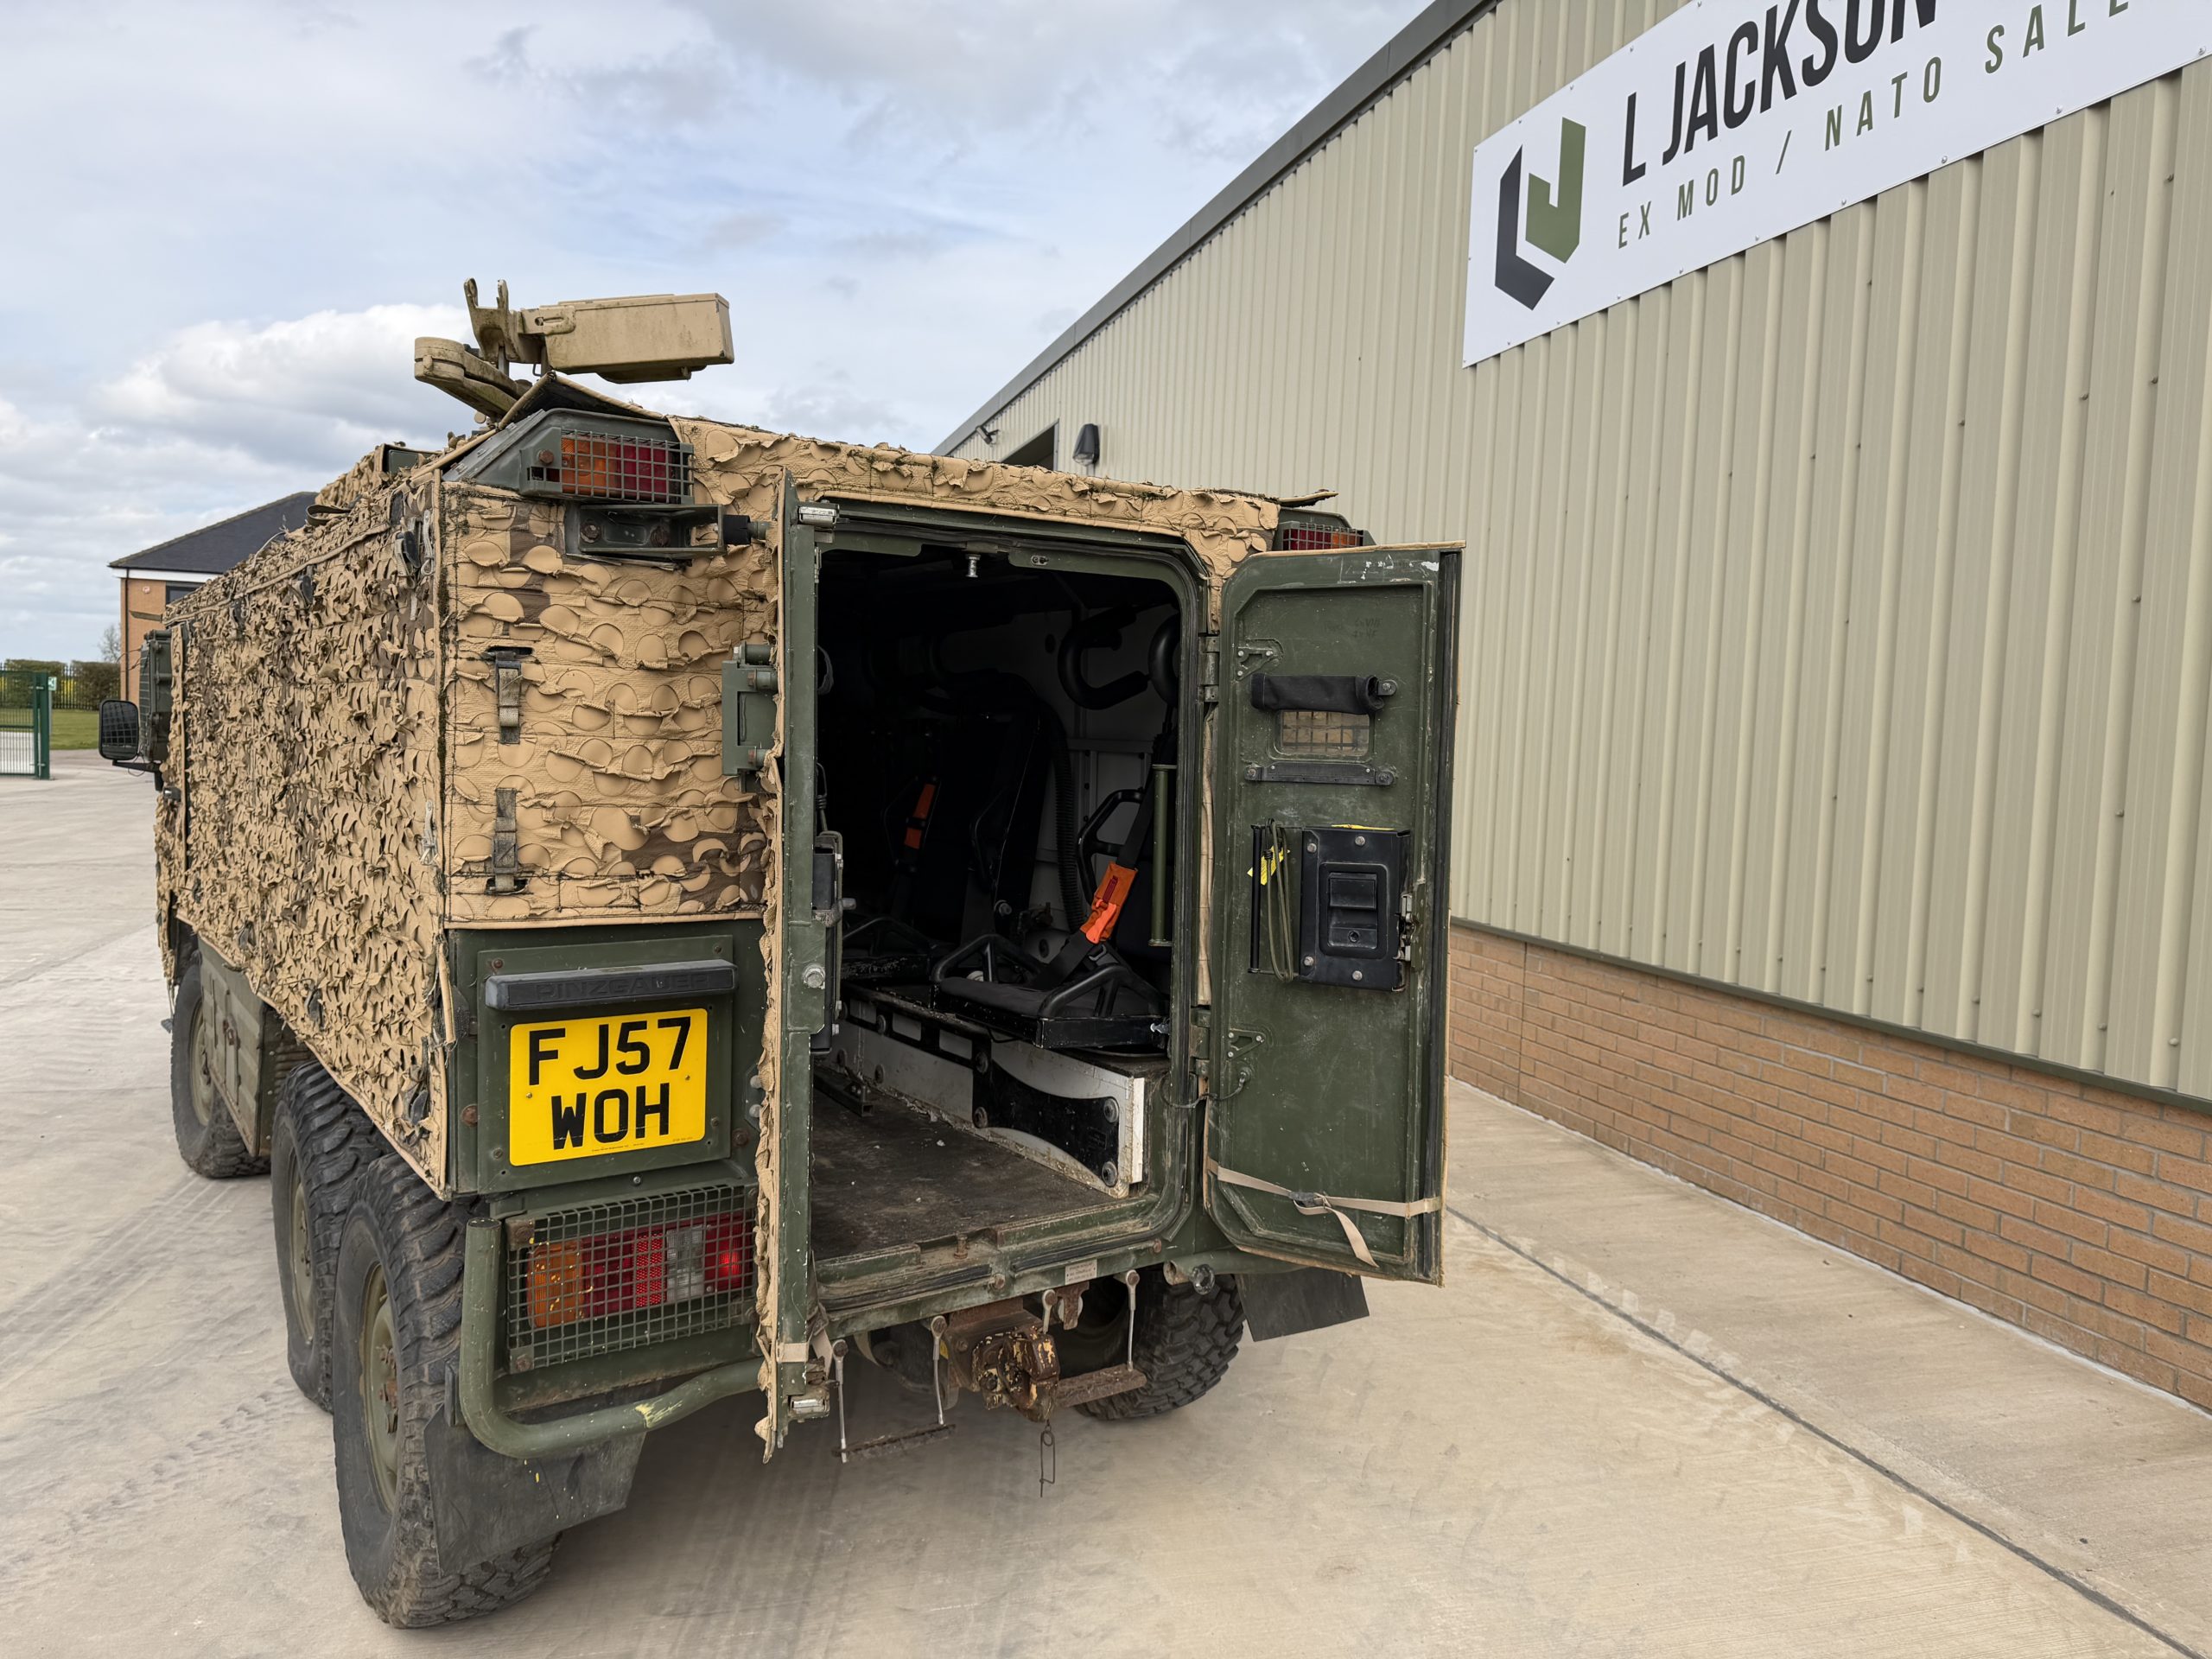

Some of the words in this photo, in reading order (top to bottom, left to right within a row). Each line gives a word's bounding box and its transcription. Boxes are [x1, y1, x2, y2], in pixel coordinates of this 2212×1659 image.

[1618, 200, 1651, 249] EX
[1677, 155, 1745, 221] MOD
[1825, 56, 1942, 151] NATO
[1623, 92, 1647, 187] L
[535, 972, 709, 1001] PINZGAUER
[528, 1016, 691, 1086] FJ57
[551, 1082, 670, 1150] WOH
